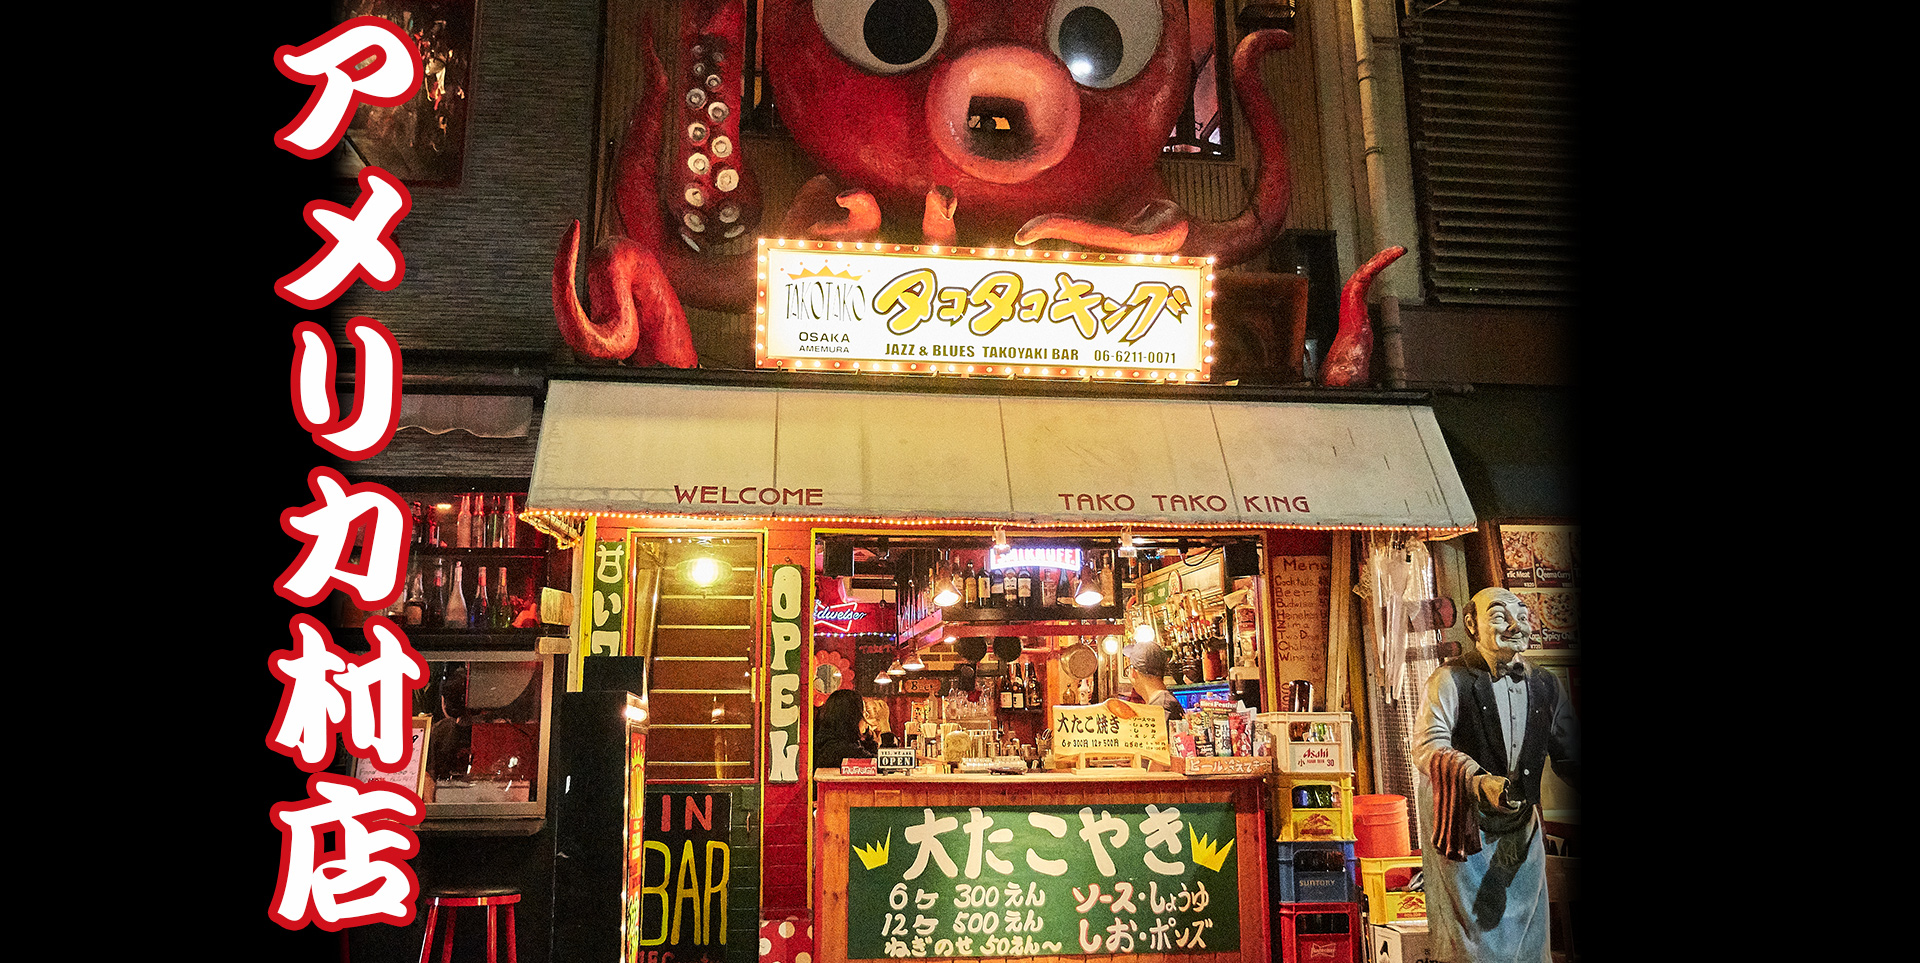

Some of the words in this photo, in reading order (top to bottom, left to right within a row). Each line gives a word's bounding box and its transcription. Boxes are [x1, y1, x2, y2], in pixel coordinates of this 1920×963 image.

[785, 281, 866, 322] TAKOTAKO
[872, 267, 1192, 346] タコタコキング
[799, 331, 850, 343] OSAKA
[799, 345, 850, 354] AMEMURA
[885, 343, 915, 356] JAZZ
[919, 346, 928, 356] &
[933, 345, 974, 358] BLUES
[982, 346, 1047, 359] TAKOYAKI
[1052, 349, 1079, 361] BAR
[1094, 349, 1176, 364] 06-6211-0071
[674, 485, 823, 506] WELCOME
[1058, 494, 1135, 511] TAKO
[1151, 495, 1227, 512] TAKO
[1243, 496, 1311, 513] KING
[1283, 557, 1328, 571] Menu
[769, 566, 801, 782] OPEN
[1057, 712, 1120, 734] 大たこ焼き
[882, 757, 911, 766] OPEN
[1303, 748, 1329, 758] Asahi
[1298, 759, 1305, 767] 小
[1327, 759, 1334, 767] 30
[661, 795, 713, 832] IN
[903, 804, 1185, 881] 大たこやき
[1299, 879, 1335, 887] SUNTORY
[640, 840, 730, 946] BAR
[954, 881, 1045, 909] 300えん
[952, 909, 1043, 934] 500えん
